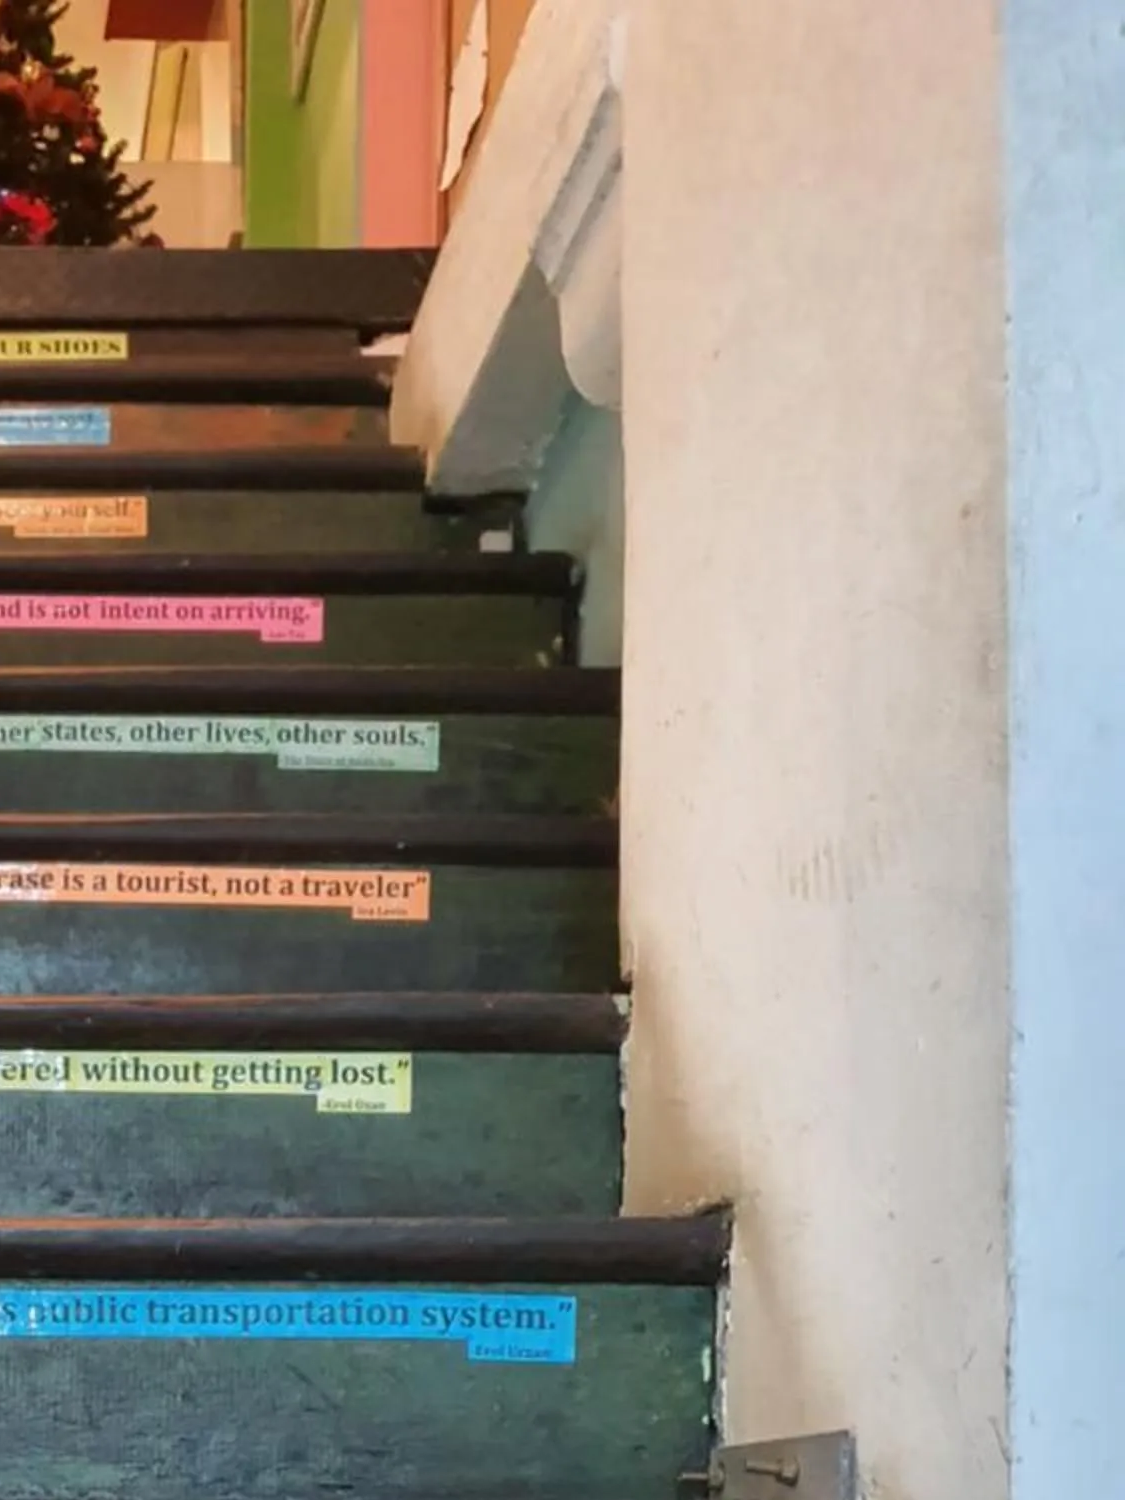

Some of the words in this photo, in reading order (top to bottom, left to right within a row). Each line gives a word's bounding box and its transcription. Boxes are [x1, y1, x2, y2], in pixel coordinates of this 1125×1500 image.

[38, 339, 122, 355] SHOES
[29, 600, 46, 618] is
[54, 602, 89, 619] not
[100, 601, 168, 619] intent
[176, 605, 203, 620] on
[41, 720, 122, 745] states,
[130, 720, 198, 744] other
[206, 720, 270, 747] lives,
[277, 721, 346, 745] other
[62, 868, 84, 891] is
[92, 875, 107, 892] a
[116, 869, 217, 898] tourist,
[225, 873, 272, 895] not
[278, 877, 294, 896] a
[81, 1058, 203, 1084] without
[211, 1059, 323, 1090] getting
[147, 1297, 409, 1334] transportation
